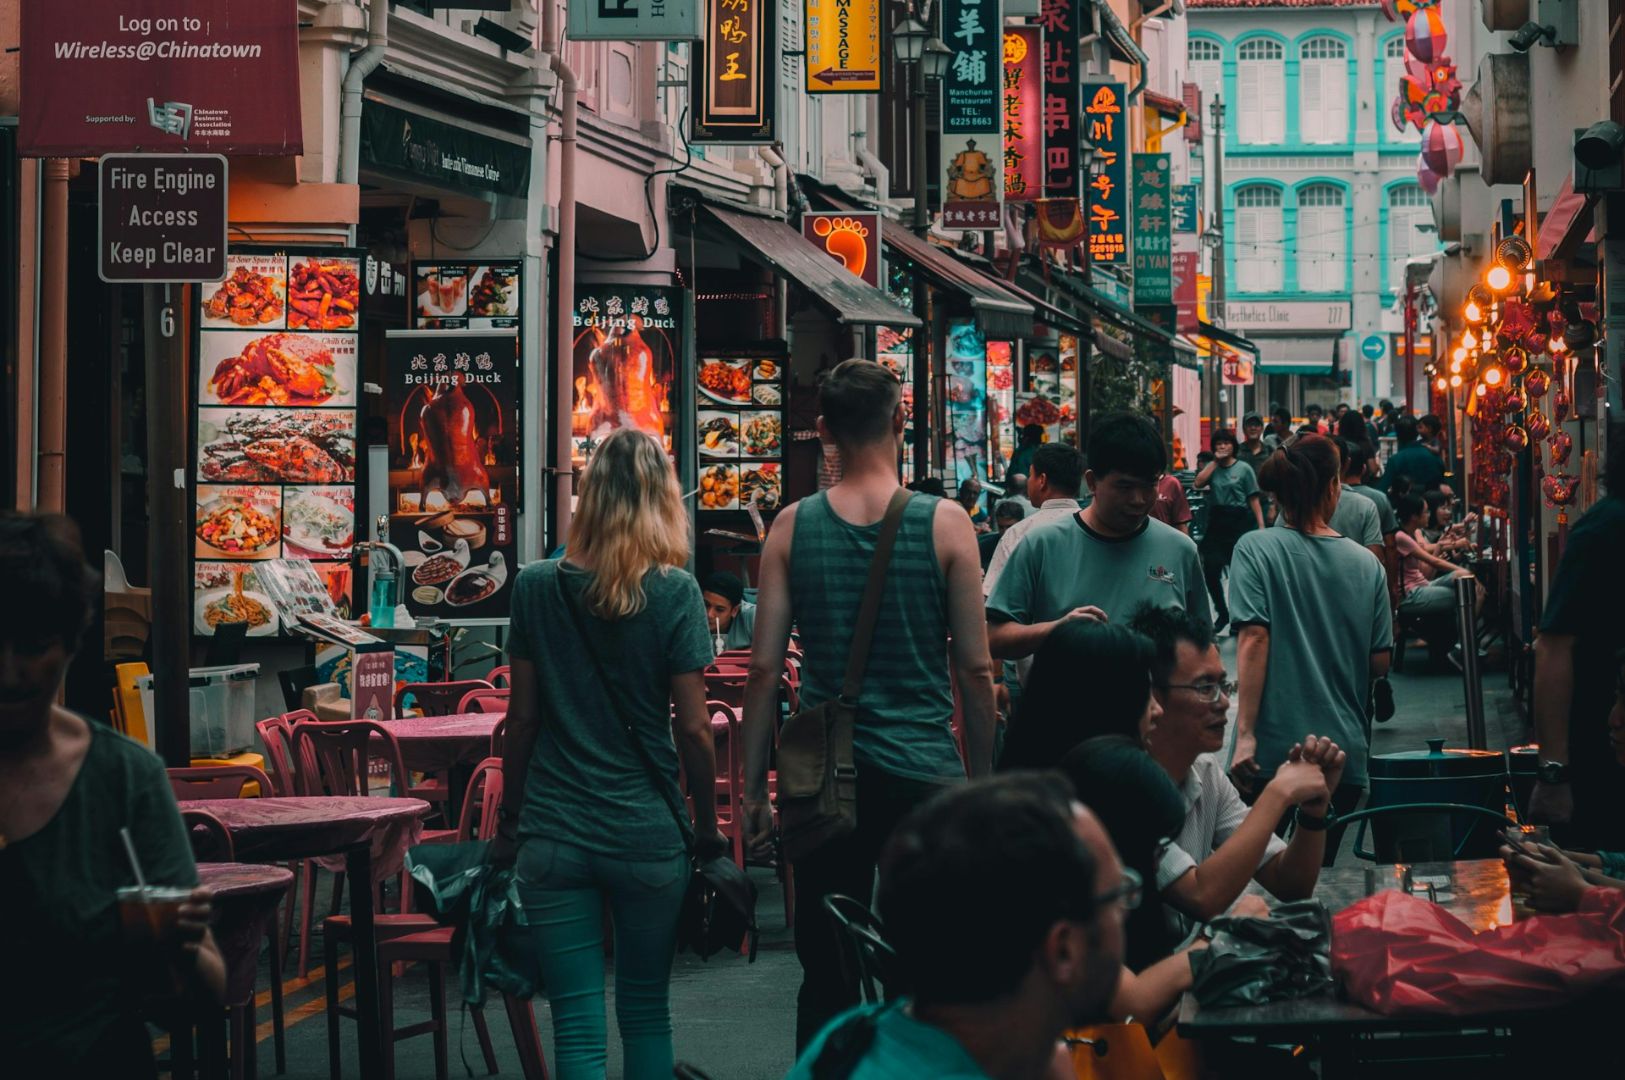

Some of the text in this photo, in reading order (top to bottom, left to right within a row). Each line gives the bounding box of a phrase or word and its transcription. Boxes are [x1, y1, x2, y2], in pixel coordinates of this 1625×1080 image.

[119, 15, 201, 35] Log on to
[837, 0, 850, 69] MASSAGE
[54, 40, 262, 60] Wireless@Chinatown
[961, 107, 980, 115] TEL:
[86, 115, 136, 124] Supported by:
[950, 117, 992, 125] 6225 8663
[111, 168, 216, 195] Fire Engine
[129, 205, 198, 226] Access
[110, 242, 216, 269] Keep Clear
[236, 256, 251, 264] Sour
[252, 256, 270, 266] Spare
[271, 256, 285, 264] Ribs
[1149, 256, 1169, 269] YAN
[1269, 305, 1290, 322] Clinic
[1328, 306, 1343, 324] 277
[573, 316, 675, 330] Beijing Duck
[341, 337, 355, 345] Crab
[405, 373, 501, 386] Beijing Duck
[198, 563, 219, 571] Fried
